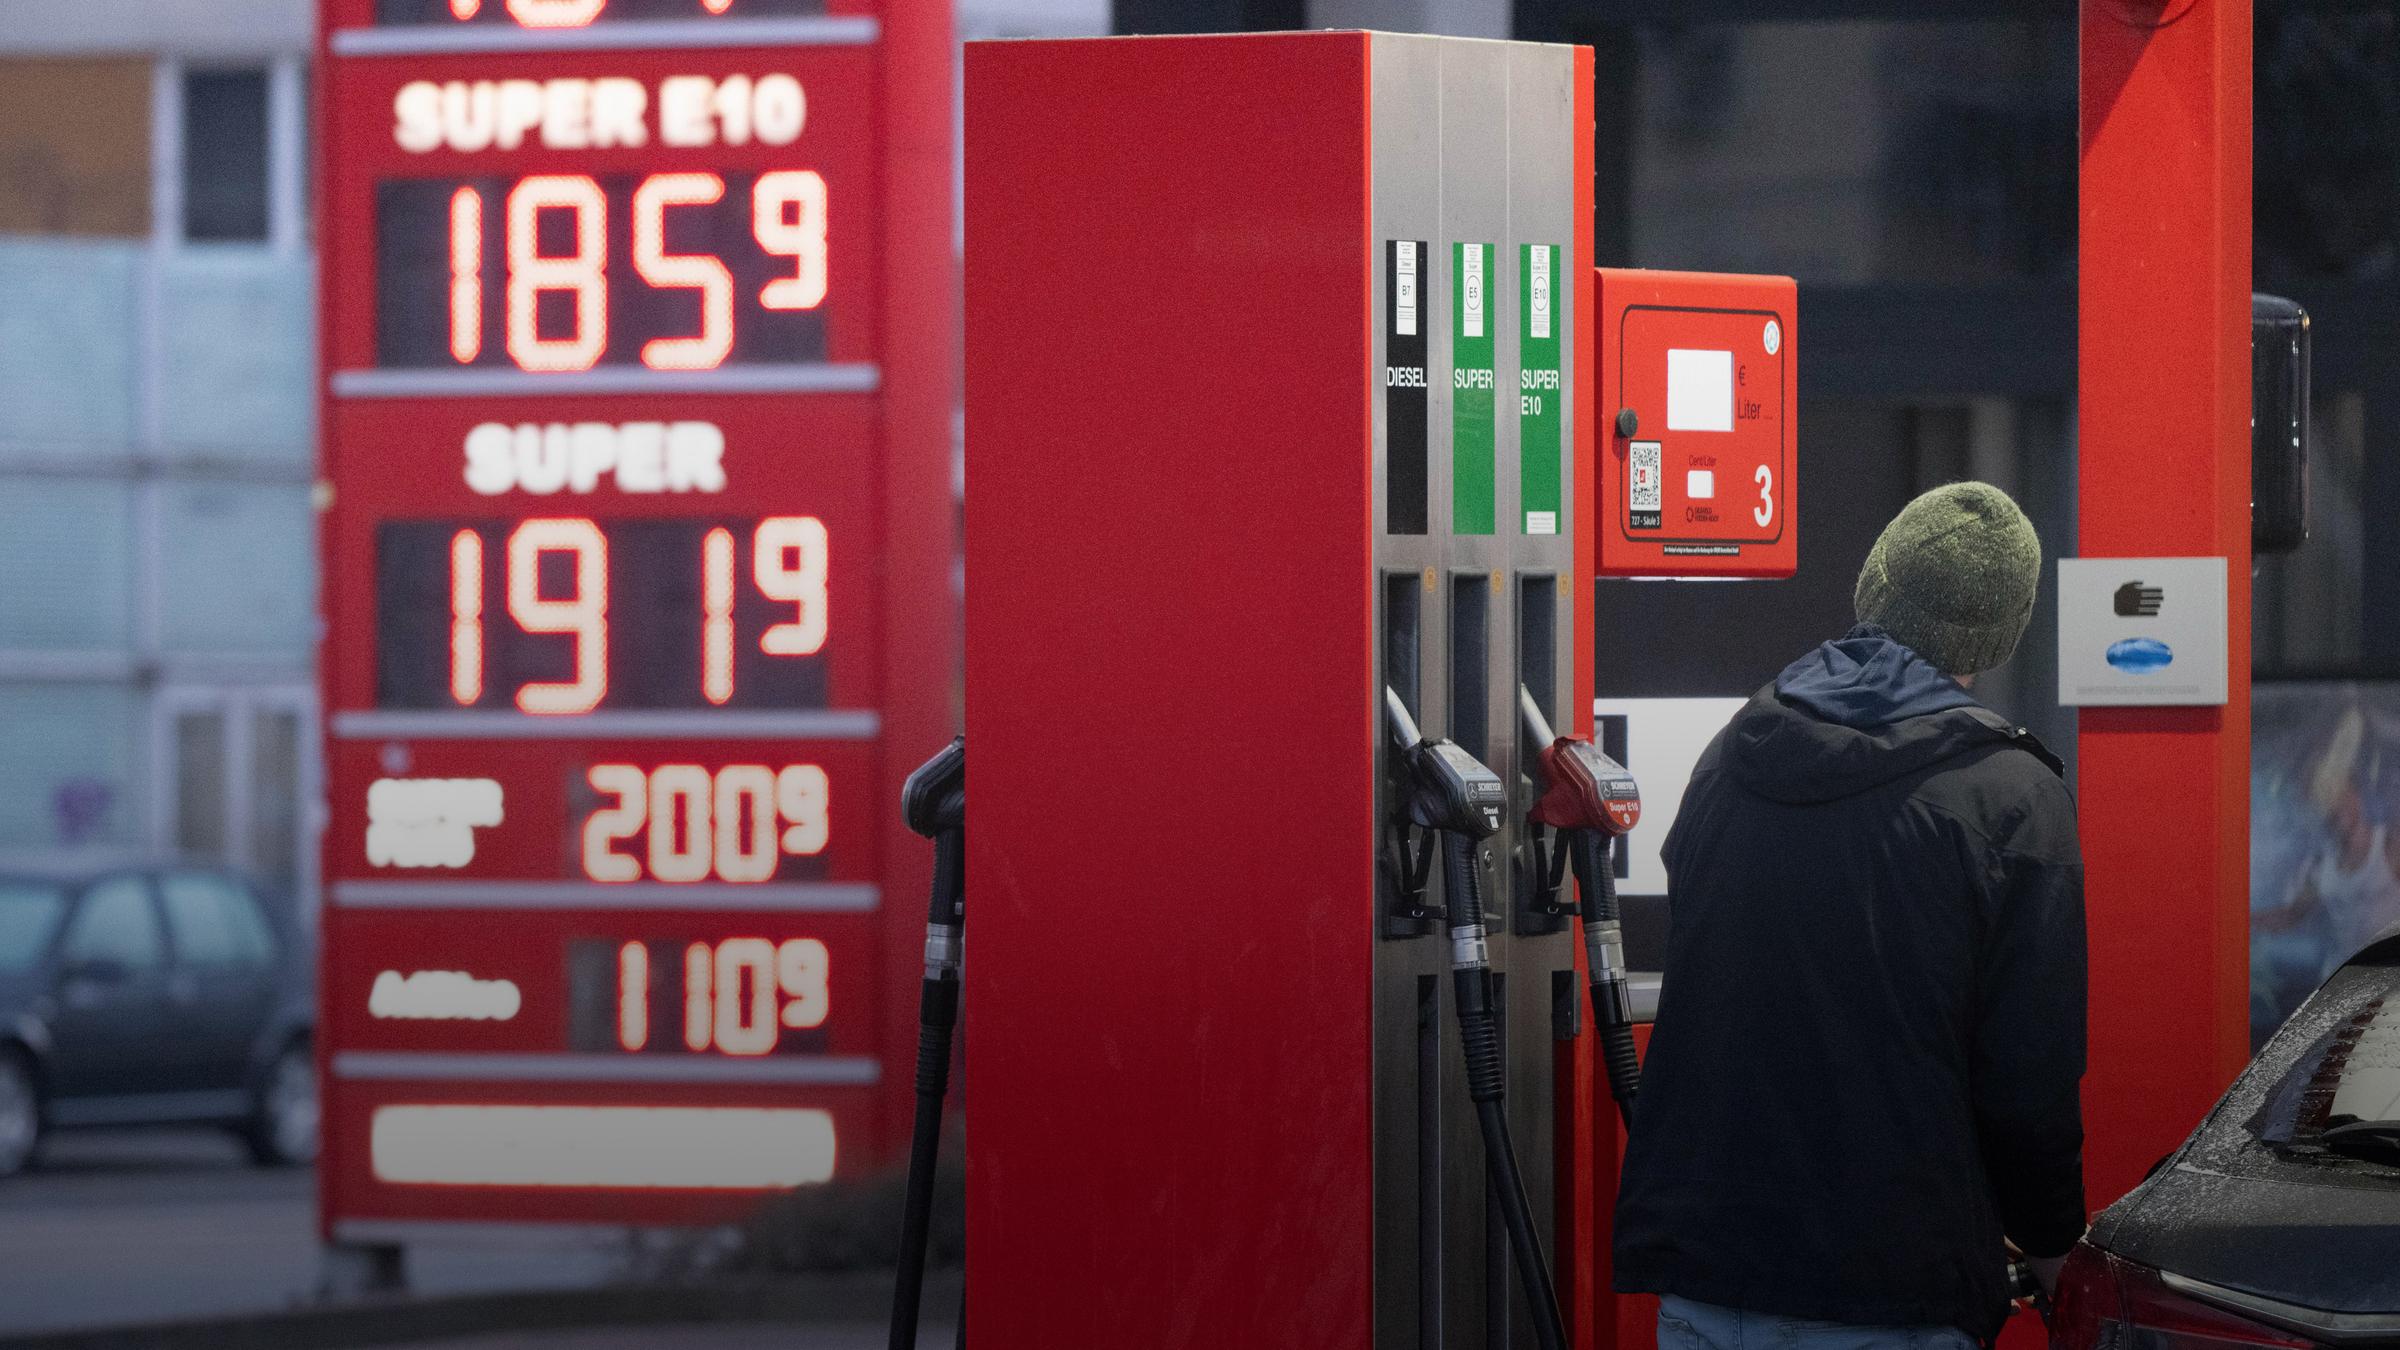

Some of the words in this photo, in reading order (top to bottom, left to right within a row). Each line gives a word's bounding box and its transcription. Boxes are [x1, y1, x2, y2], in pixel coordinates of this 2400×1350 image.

[394, 77, 648, 153] SUPER
[659, 73, 807, 147] E10
[1402, 285, 1411, 296] B7
[1469, 287, 1478, 298] E5
[1534, 288, 1547, 300] E10
[1386, 366, 1427, 388] DIESEL
[1454, 368, 1493, 389] SUPER
[1521, 369, 1559, 390] SUPER
[1738, 364, 1746, 387] €
[1521, 396, 1542, 416] E10
[1737, 398, 1761, 420] Liter
[464, 421, 727, 495] SUPER
[1754, 464, 1773, 527] 3
[1609, 802, 1626, 813] Super
[1626, 802, 1639, 812] E10
